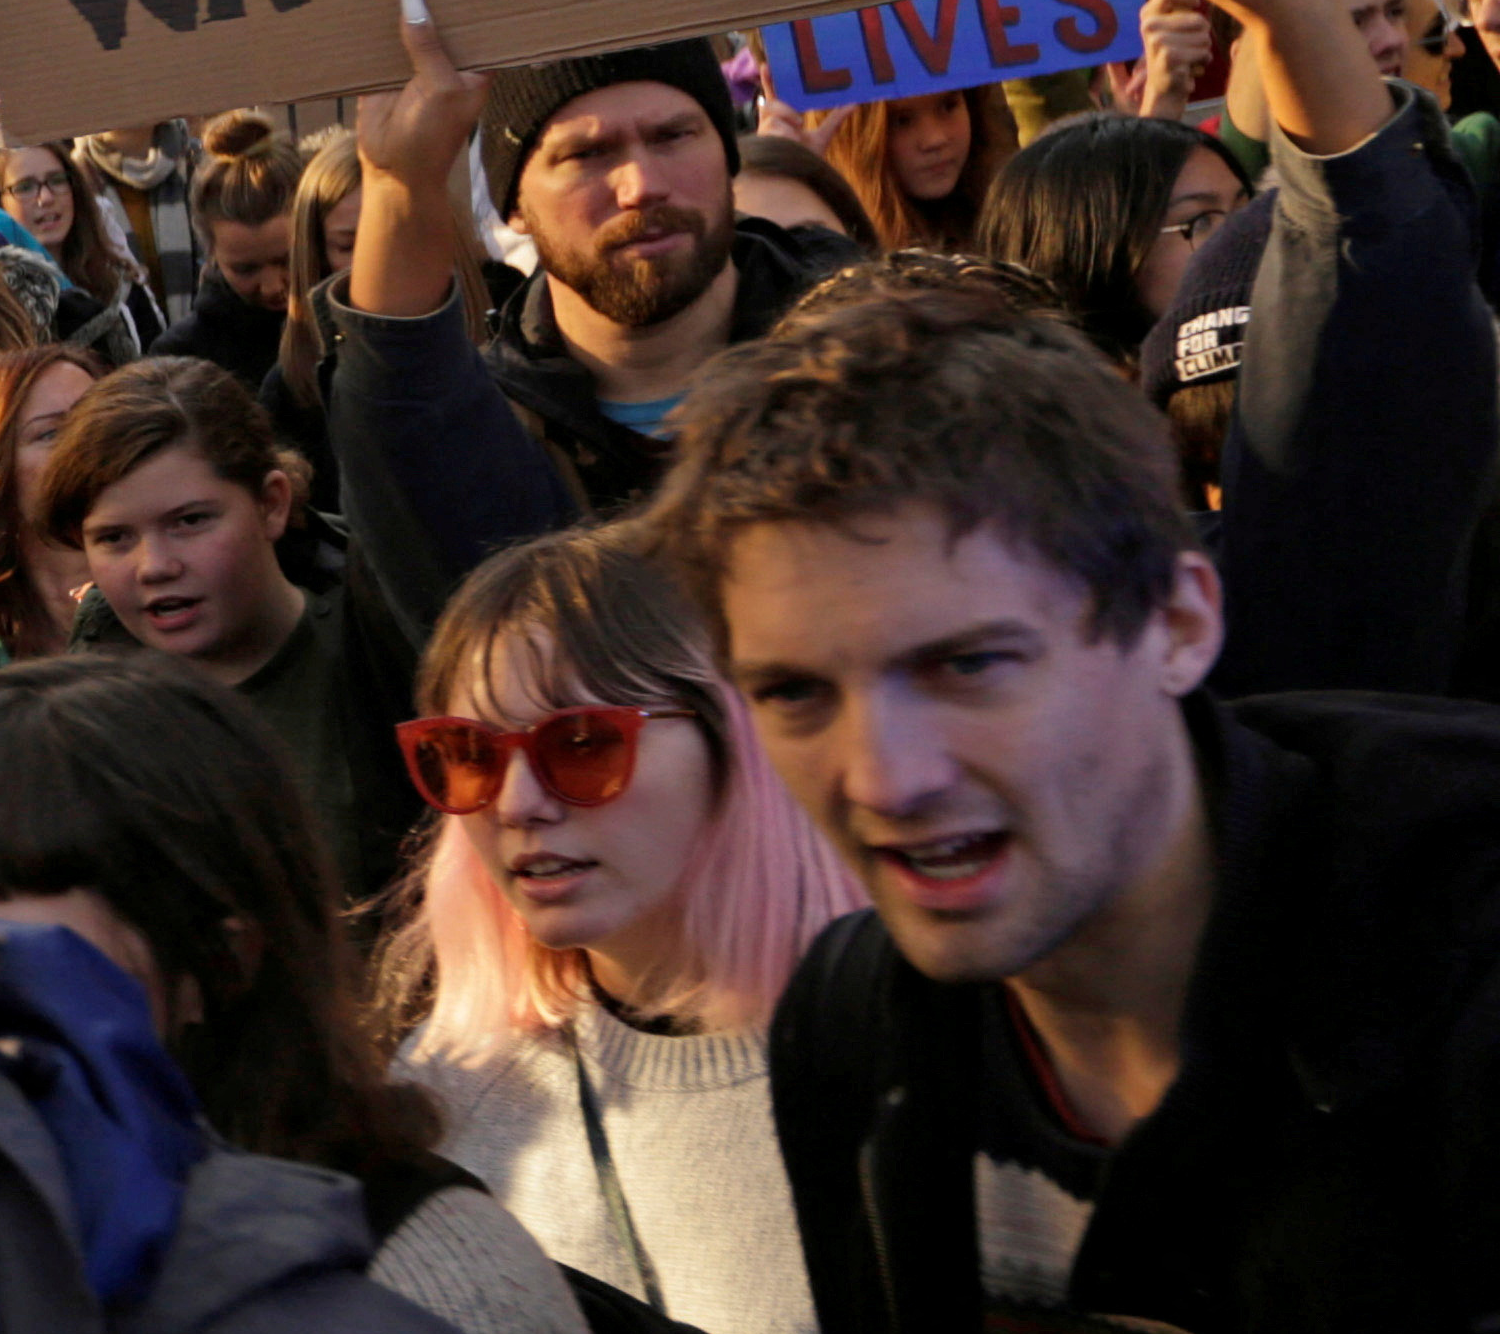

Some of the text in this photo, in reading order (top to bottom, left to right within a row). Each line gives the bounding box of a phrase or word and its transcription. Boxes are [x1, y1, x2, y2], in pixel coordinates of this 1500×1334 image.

[1178, 306, 1252, 338] CHANG
[1176, 330, 1218, 358] FOR
[1182, 344, 1244, 376] CLIM
